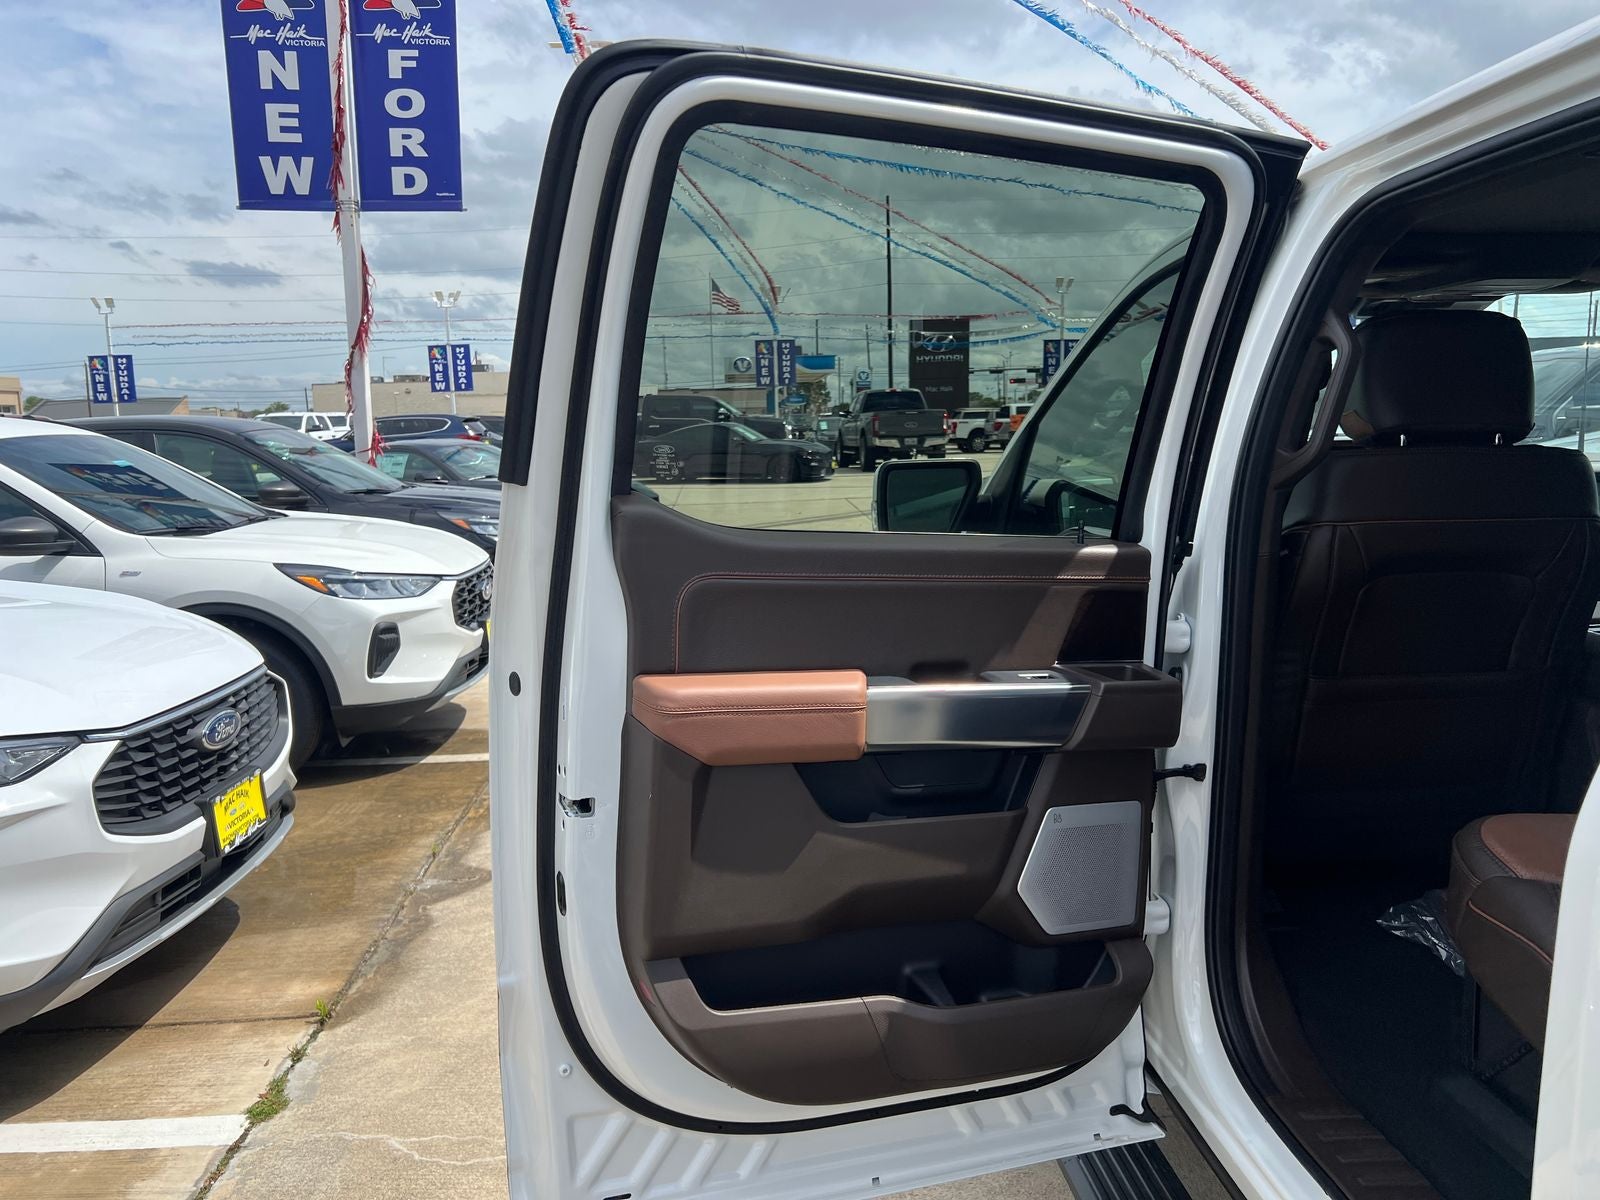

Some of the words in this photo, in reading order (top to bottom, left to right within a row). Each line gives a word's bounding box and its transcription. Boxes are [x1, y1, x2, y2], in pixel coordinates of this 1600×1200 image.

[247, 24, 274, 45] Mac
[275, 23, 309, 45] Haik
[284, 38, 326, 47] VICTORIA
[373, 23, 399, 44] Mac
[401, 22, 434, 44] Haik
[410, 38, 451, 46] VICTORIA
[257, 49, 315, 196] NEW
[384, 49, 429, 196] FORD
[434, 363, 446, 391] NEW
[455, 347, 467, 390] HYUNDAI
[760, 358, 771, 385] NEW
[781, 342, 791, 384] HYUNDAI
[94, 373, 107, 401] NEW
[117, 357, 130, 400] HYUNDAI
[214, 720, 236, 742] Ford
